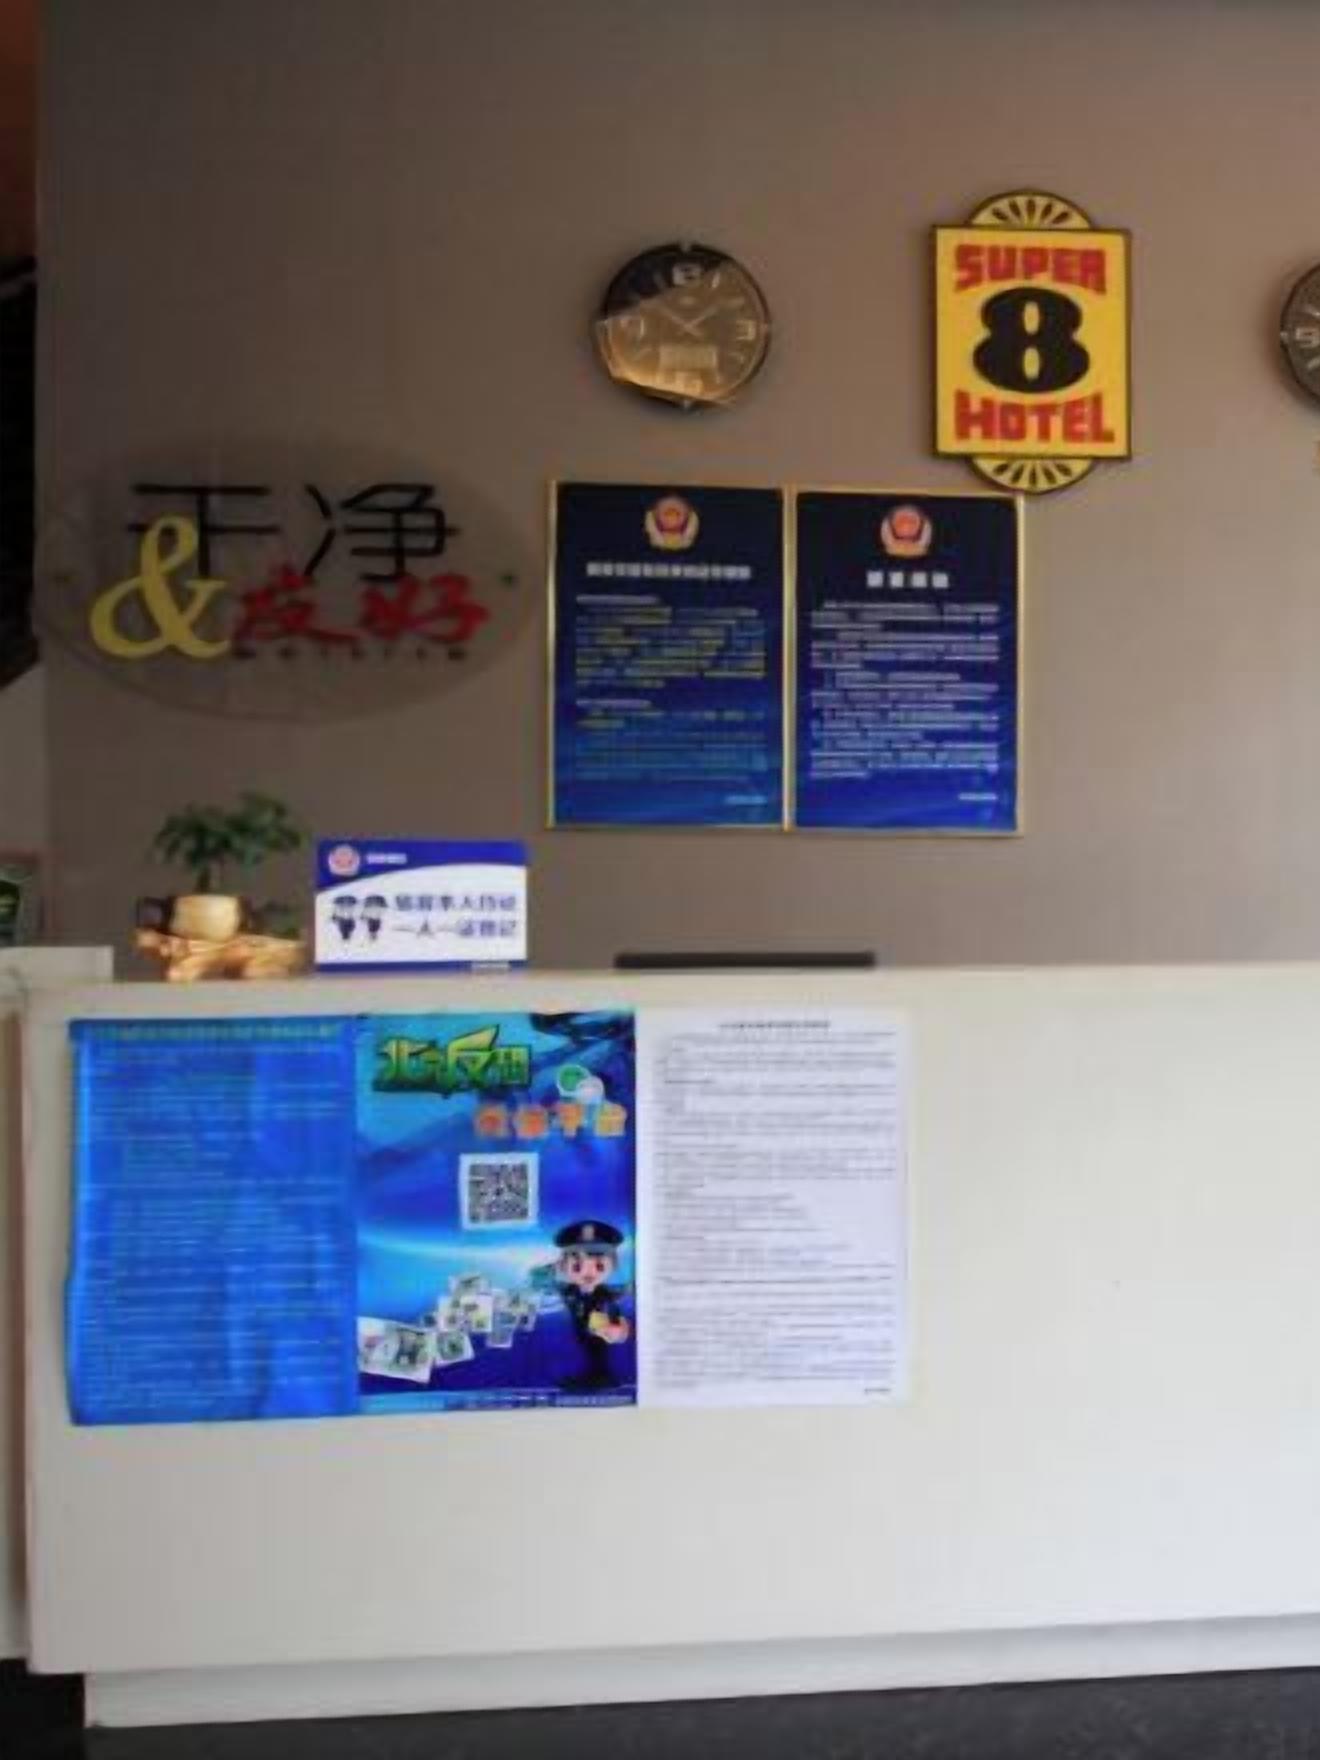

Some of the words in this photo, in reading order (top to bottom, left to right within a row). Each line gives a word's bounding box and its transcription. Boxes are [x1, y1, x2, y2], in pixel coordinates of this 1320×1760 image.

[953, 243, 1107, 296] SUPER
[972, 286, 1090, 394] 8
[954, 387, 1115, 443] HOTEL
[127, 482, 459, 583] 干净
[89, 511, 234, 660] &
